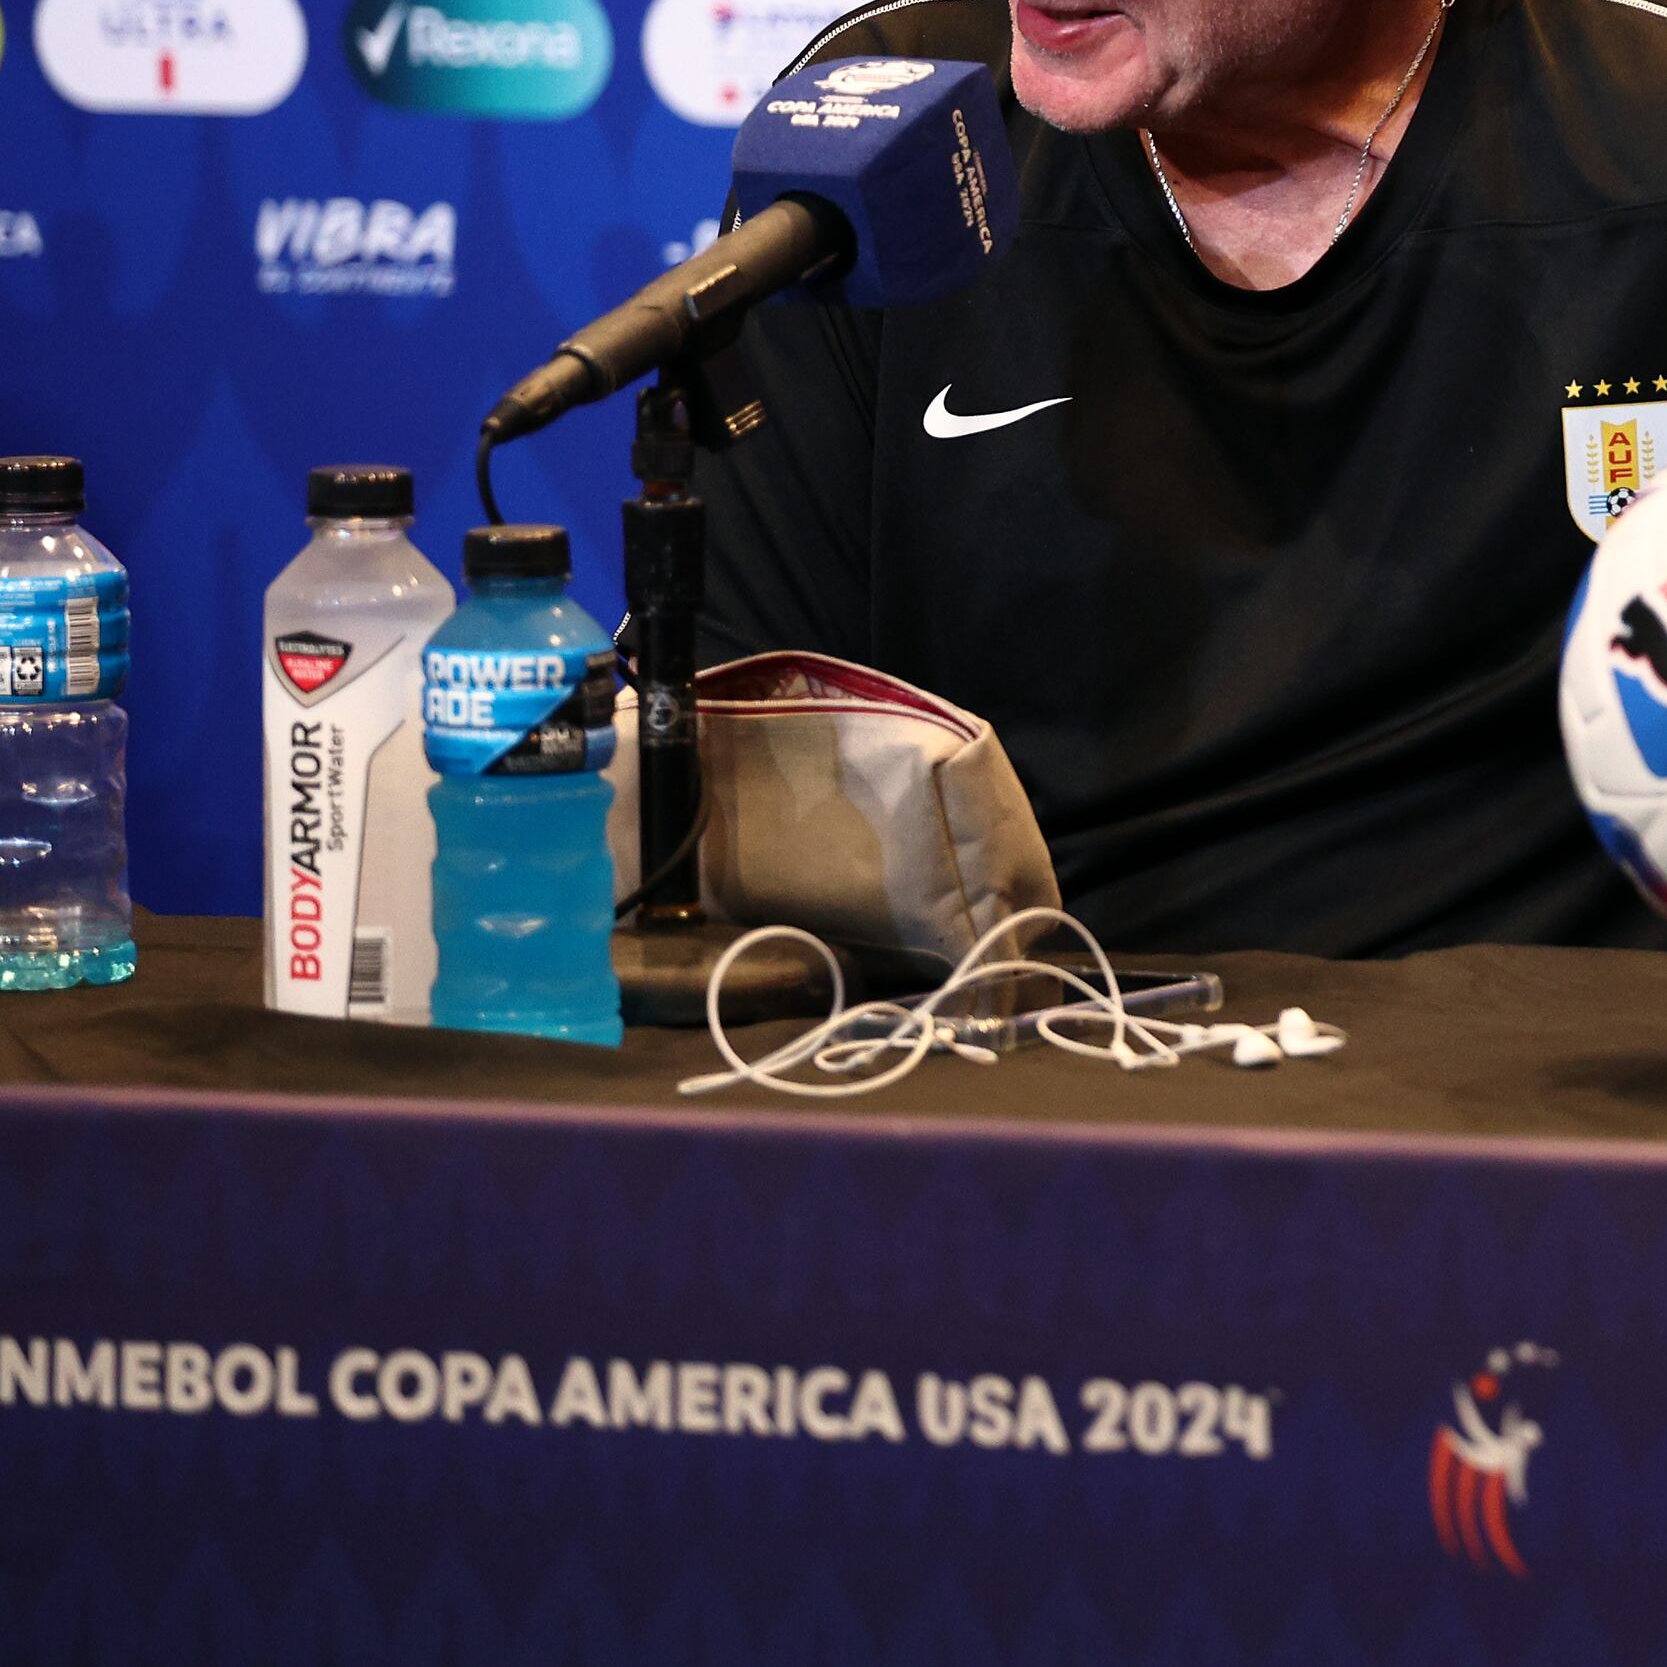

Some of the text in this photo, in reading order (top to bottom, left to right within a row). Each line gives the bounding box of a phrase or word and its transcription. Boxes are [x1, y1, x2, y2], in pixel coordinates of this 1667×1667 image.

[410, 12, 577, 64] Rexona
[952, 108, 993, 254] COPA AMERICA
[255, 196, 457, 265] VIBRA
[1608, 432, 1633, 484] AUF
[426, 652, 566, 691] POWER
[427, 687, 496, 727] ADE
[290, 719, 323, 982] BODYARMOR
[330, 1348, 542, 1425] COPA
[551, 1358, 905, 1442] AMERICA
[917, 1373, 1068, 1454] USA
[1081, 1379, 1272, 1459] 2024
